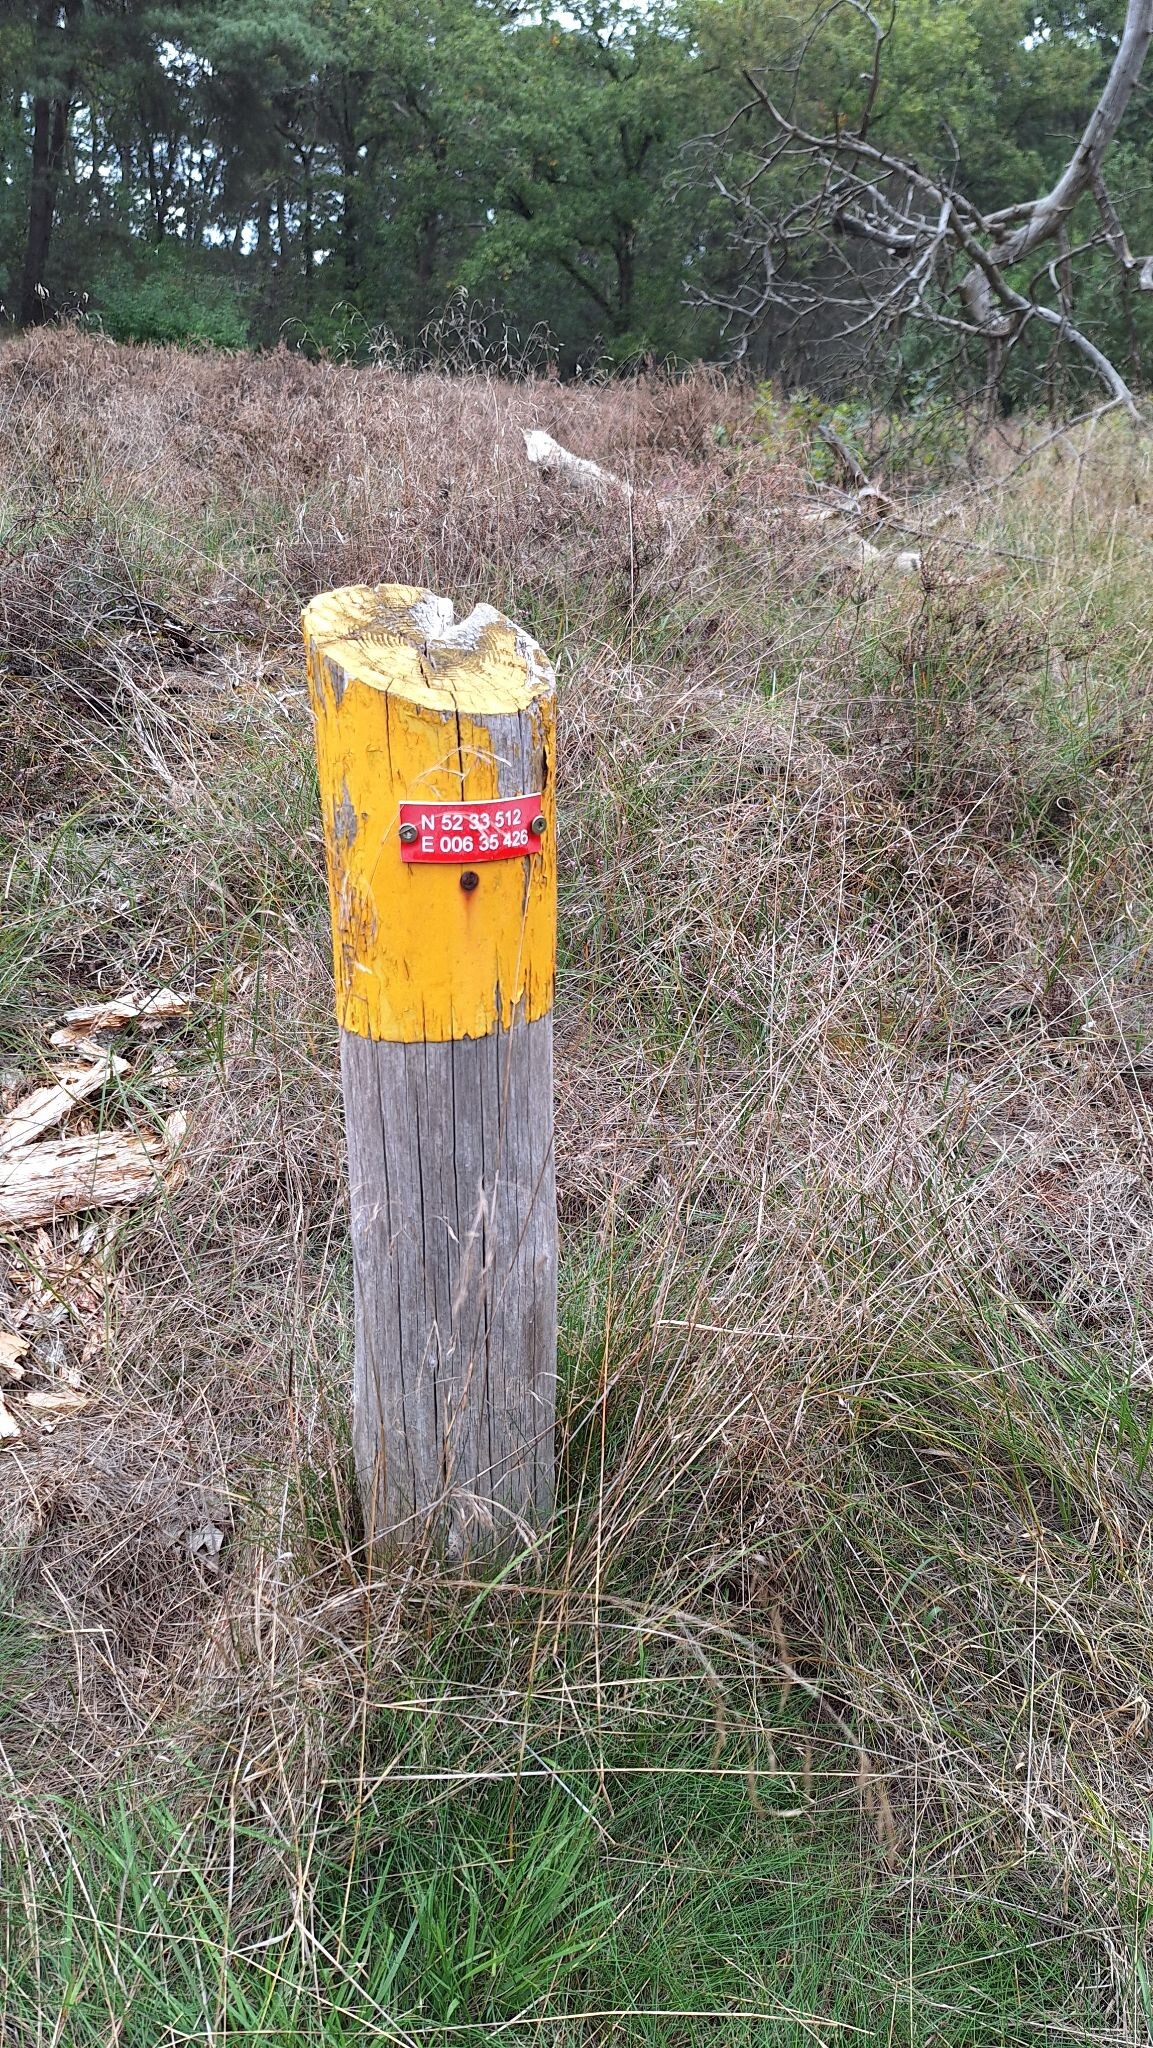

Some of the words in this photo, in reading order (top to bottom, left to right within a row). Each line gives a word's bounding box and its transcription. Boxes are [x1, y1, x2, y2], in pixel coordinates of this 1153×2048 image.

[421, 814, 435, 830] N
[441, 814, 463, 831] 52
[468, 813, 491, 831] 33
[495, 809, 522, 828] 512
[421, 836, 435, 852] E
[439, 836, 473, 853] 006
[479, 834, 499, 851] 35
[503, 829, 528, 848] 426
